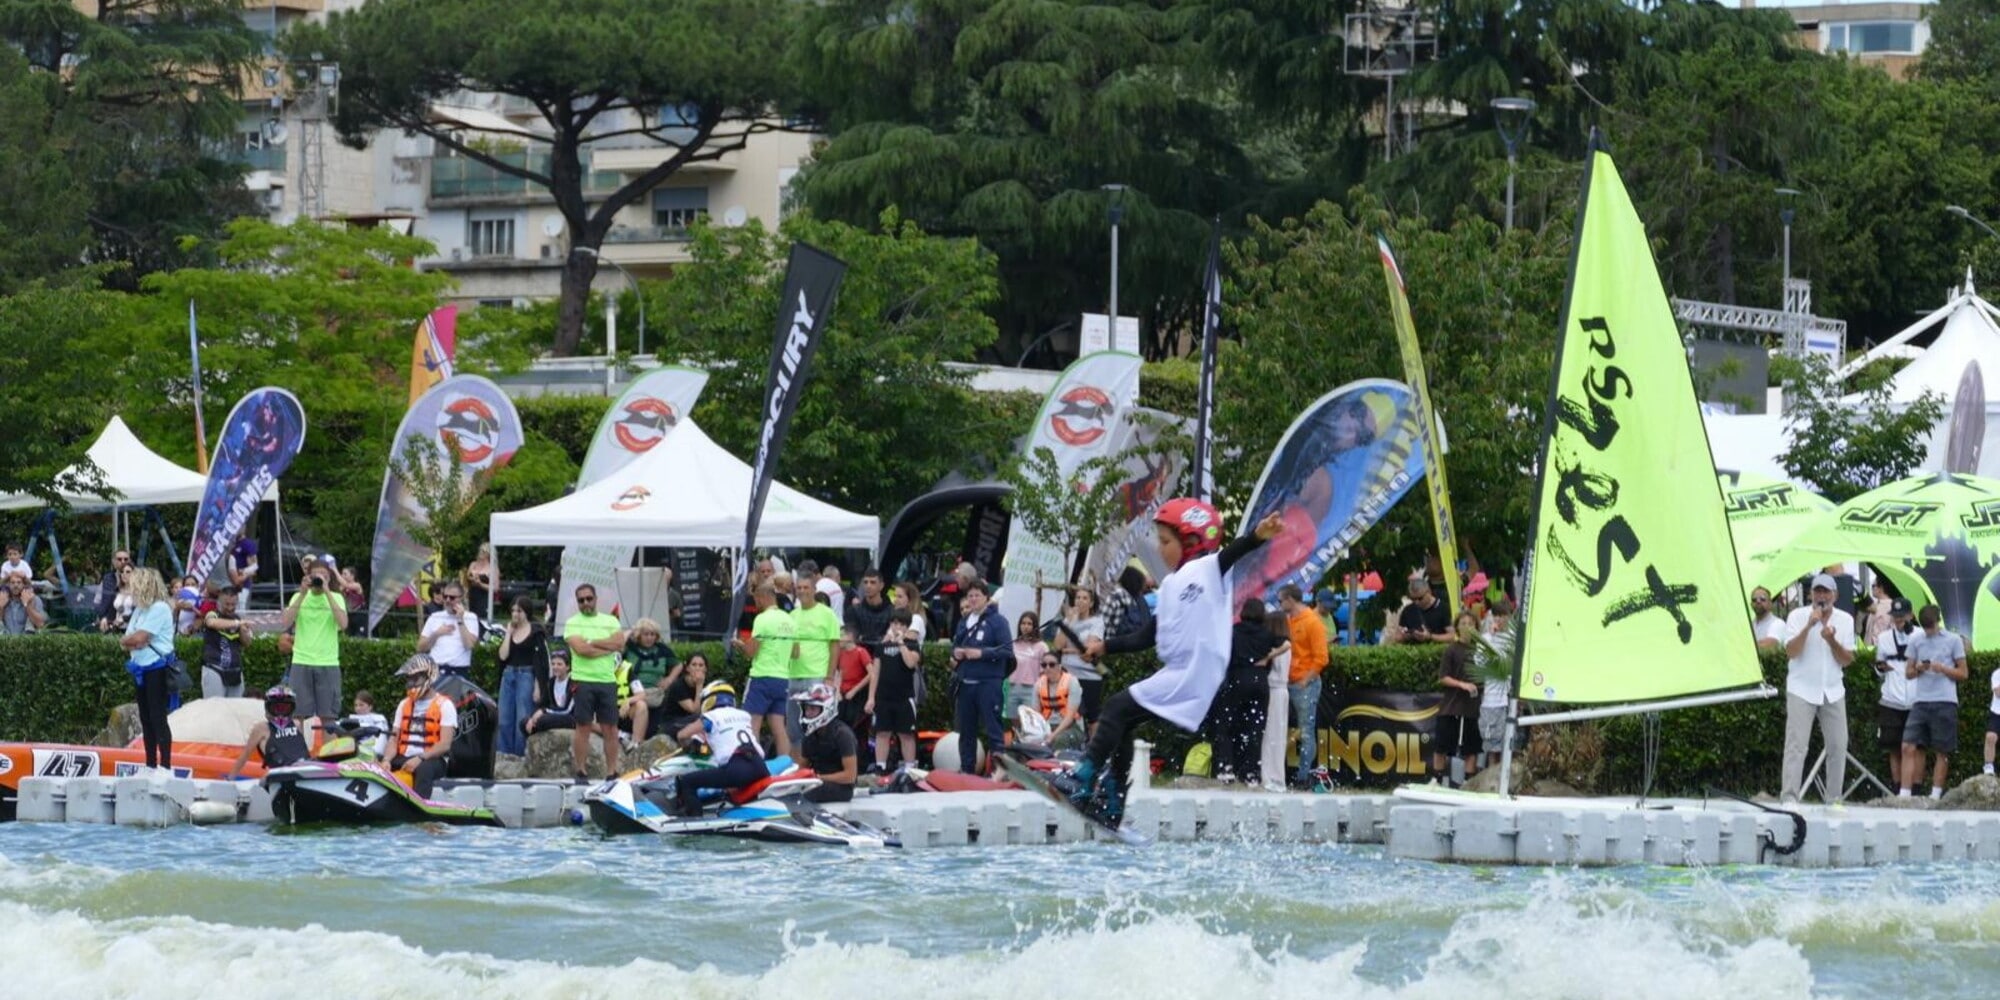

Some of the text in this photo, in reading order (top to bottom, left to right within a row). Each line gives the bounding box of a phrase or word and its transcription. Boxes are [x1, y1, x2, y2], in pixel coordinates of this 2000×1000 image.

[1847, 505, 1940, 527] JRT
[1285, 471, 1410, 590] AMENTO
[345, 779, 370, 803] 4
